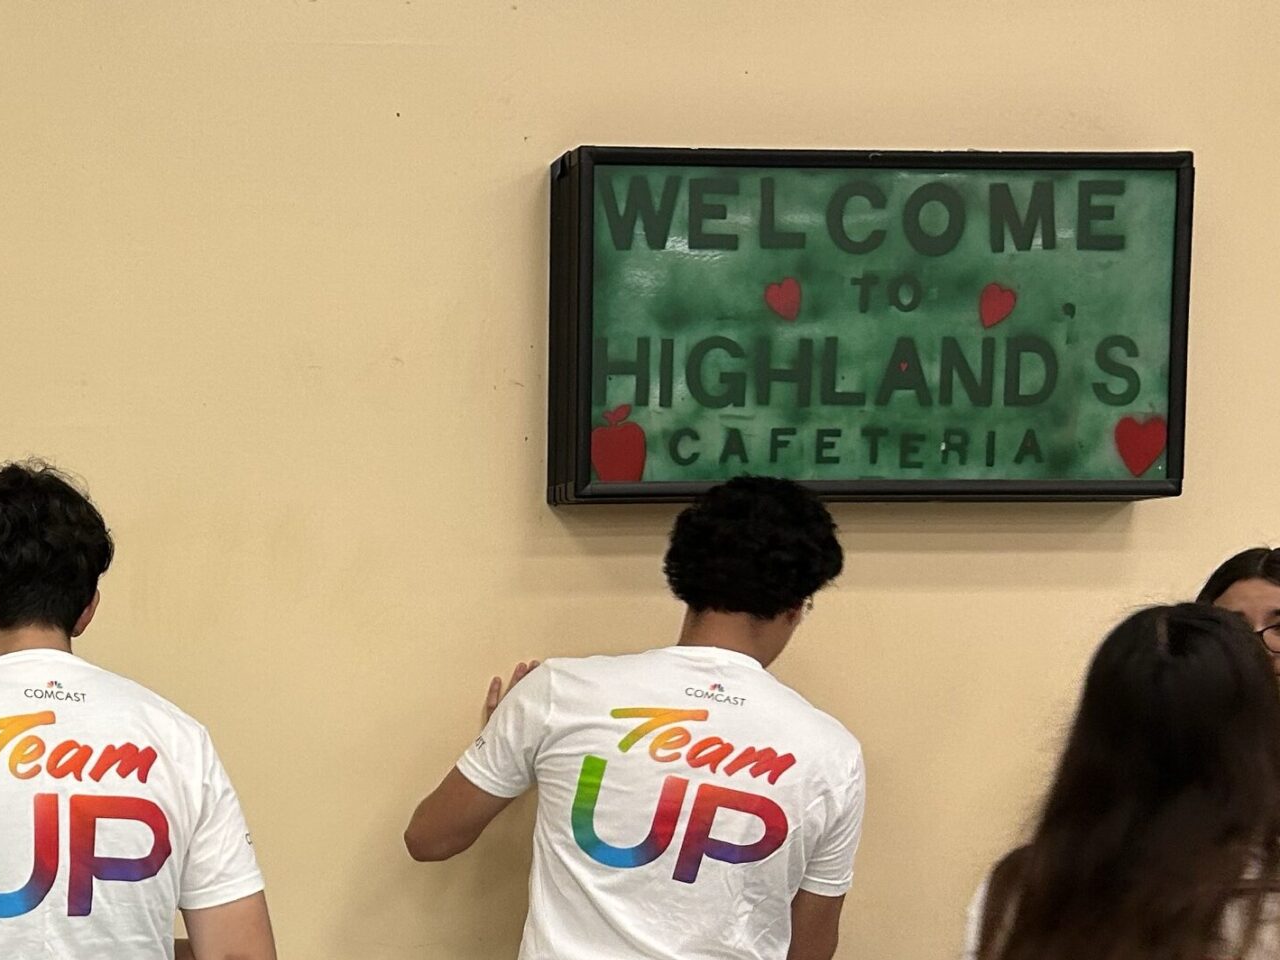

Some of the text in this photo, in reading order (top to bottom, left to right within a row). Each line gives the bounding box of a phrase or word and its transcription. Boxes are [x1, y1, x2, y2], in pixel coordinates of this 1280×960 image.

[598, 174, 1126, 256] WELCOME
[851, 273, 921, 313] TO
[668, 427, 1044, 469] CAFETERIA
[23, 688, 87, 703] COMCAST
[684, 687, 747, 708] COMCAST
[610, 707, 797, 786] Team
[571, 754, 789, 884] UP
